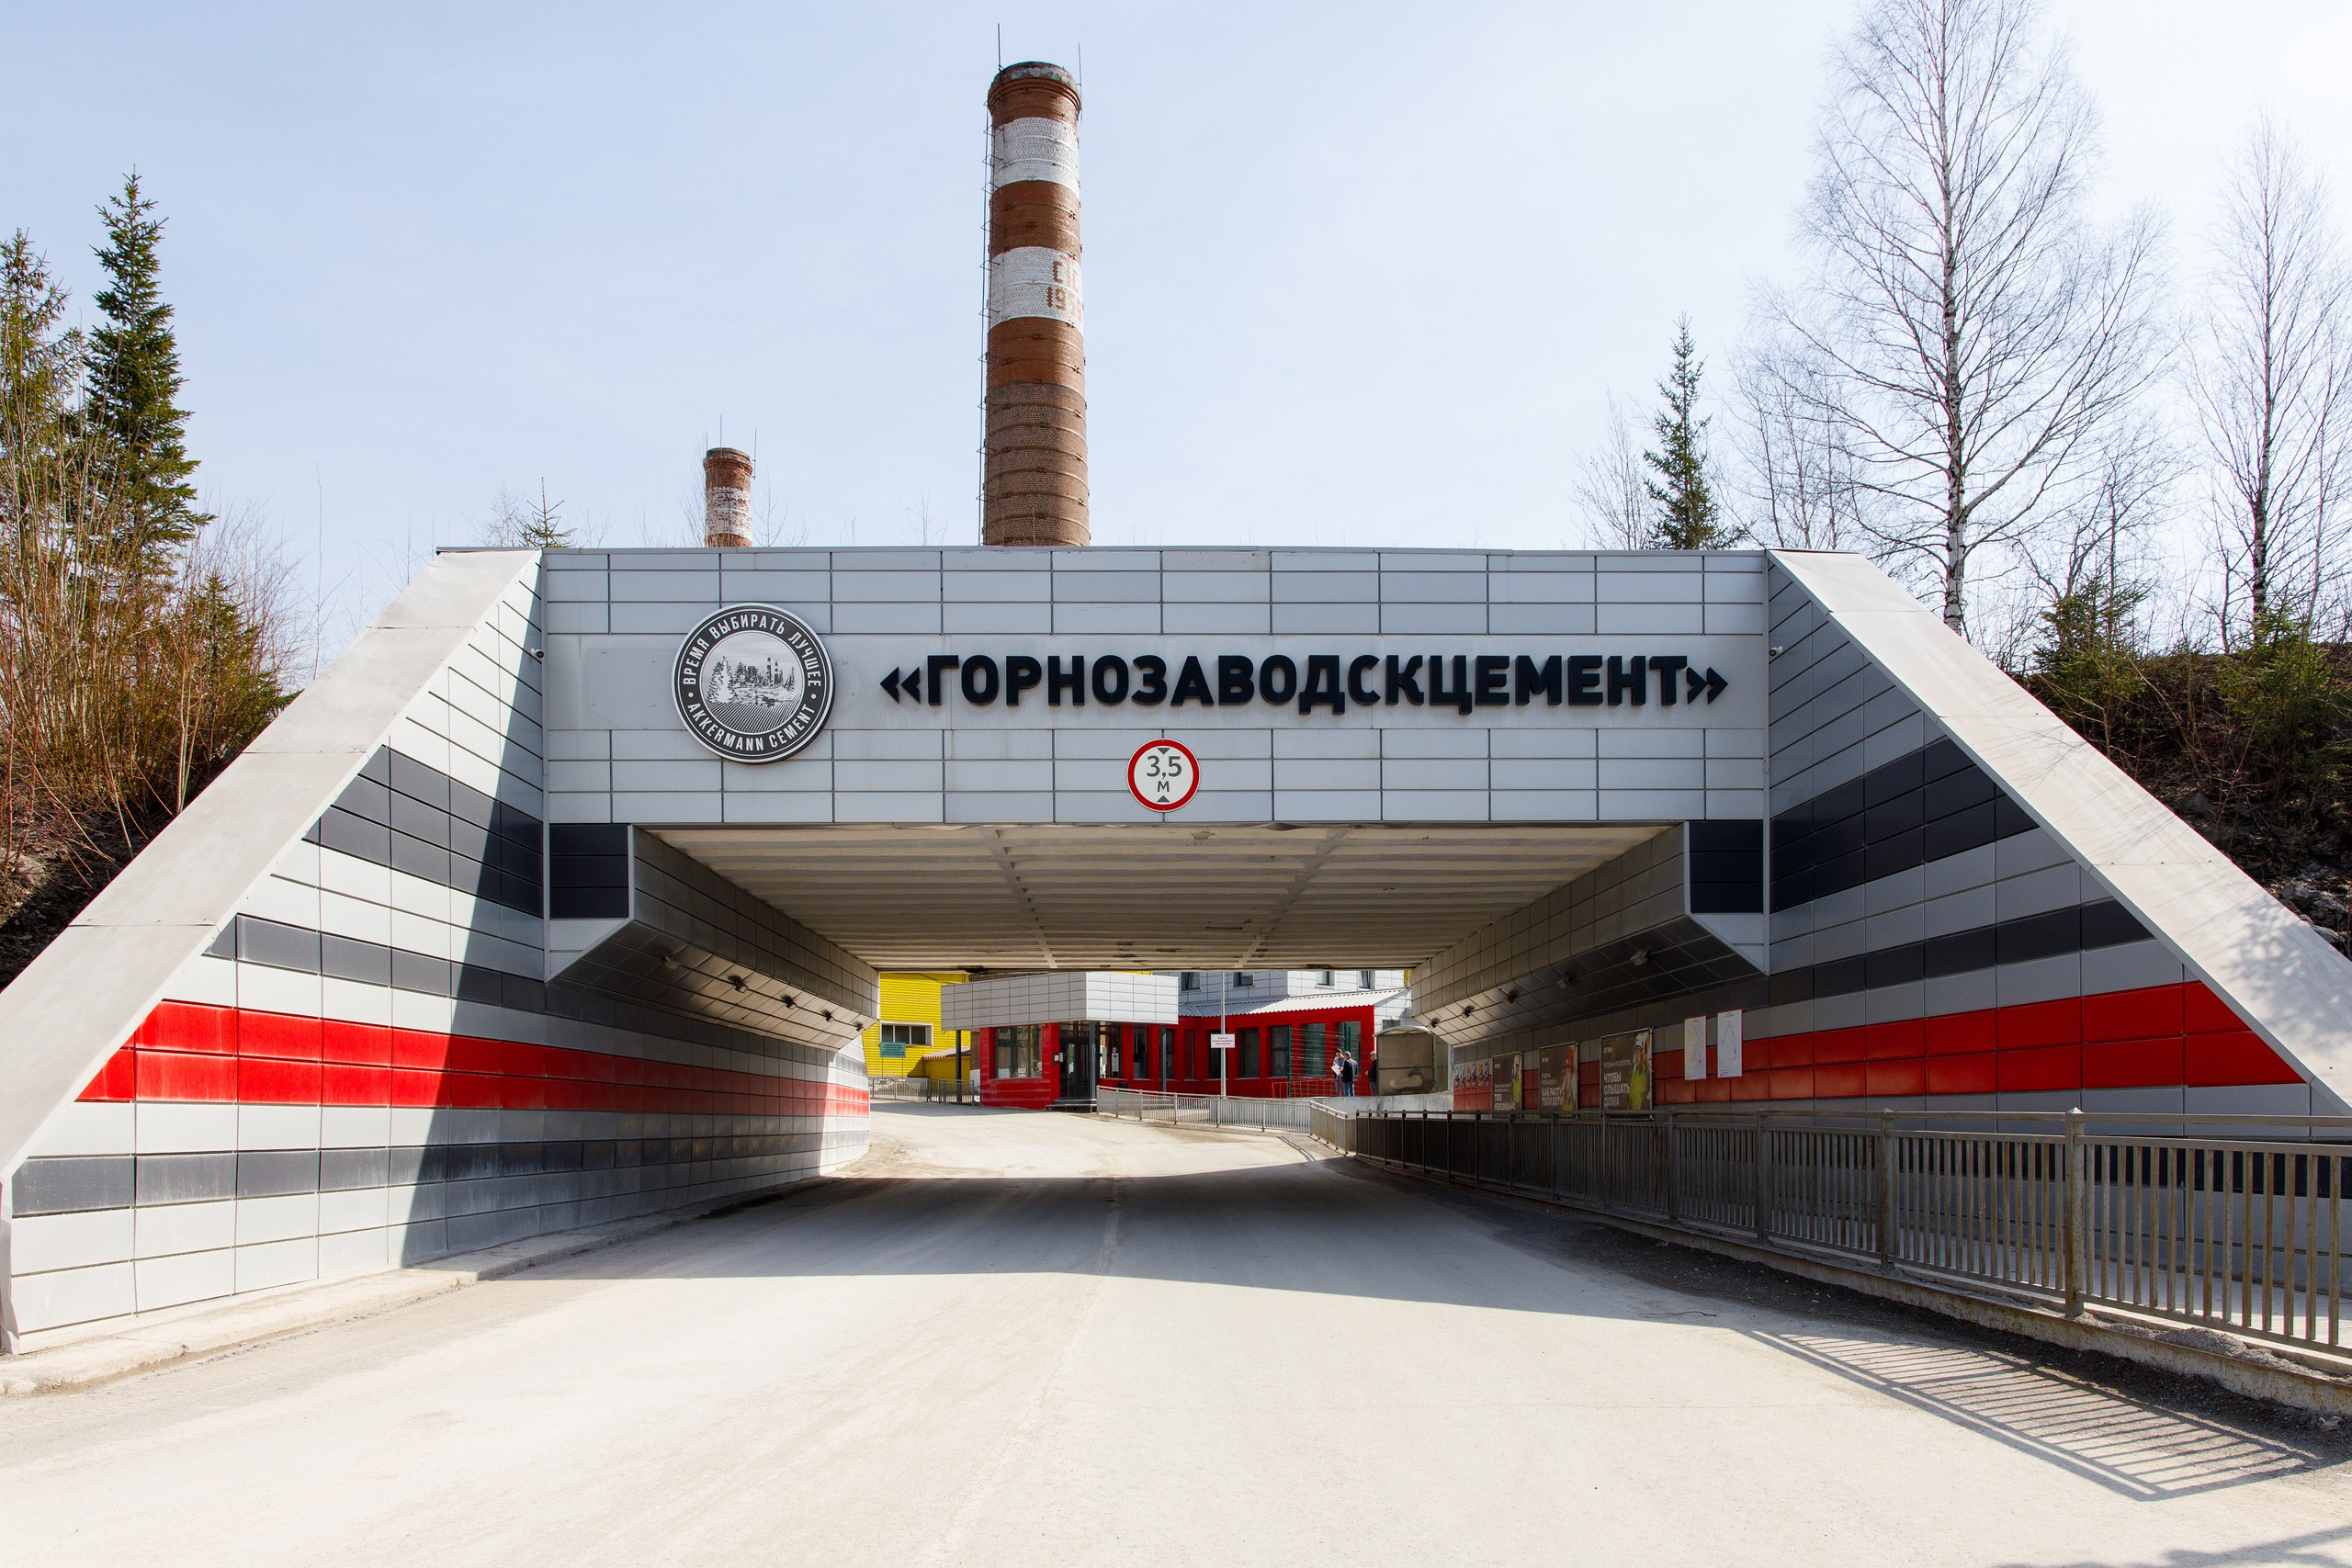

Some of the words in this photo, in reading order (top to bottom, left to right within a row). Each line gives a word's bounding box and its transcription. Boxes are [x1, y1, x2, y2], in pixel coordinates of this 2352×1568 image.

[684, 637, 709, 685] ВРЕМЯ
[708, 614, 786, 640] ВЫБИРАТЬ
[787, 631, 821, 687] ЛУЧШЕЕ
[688, 703, 764, 751] AKKERMANN
[768, 704, 816, 749] CEMENT
[1147, 755, 1182, 780] 3,5
[1604, 1071, 1621, 1083] ЧТОБЫ
[1604, 1083, 1630, 1095] СЛЫШАТЬ
[1604, 1097, 1621, 1109] ДОМА
